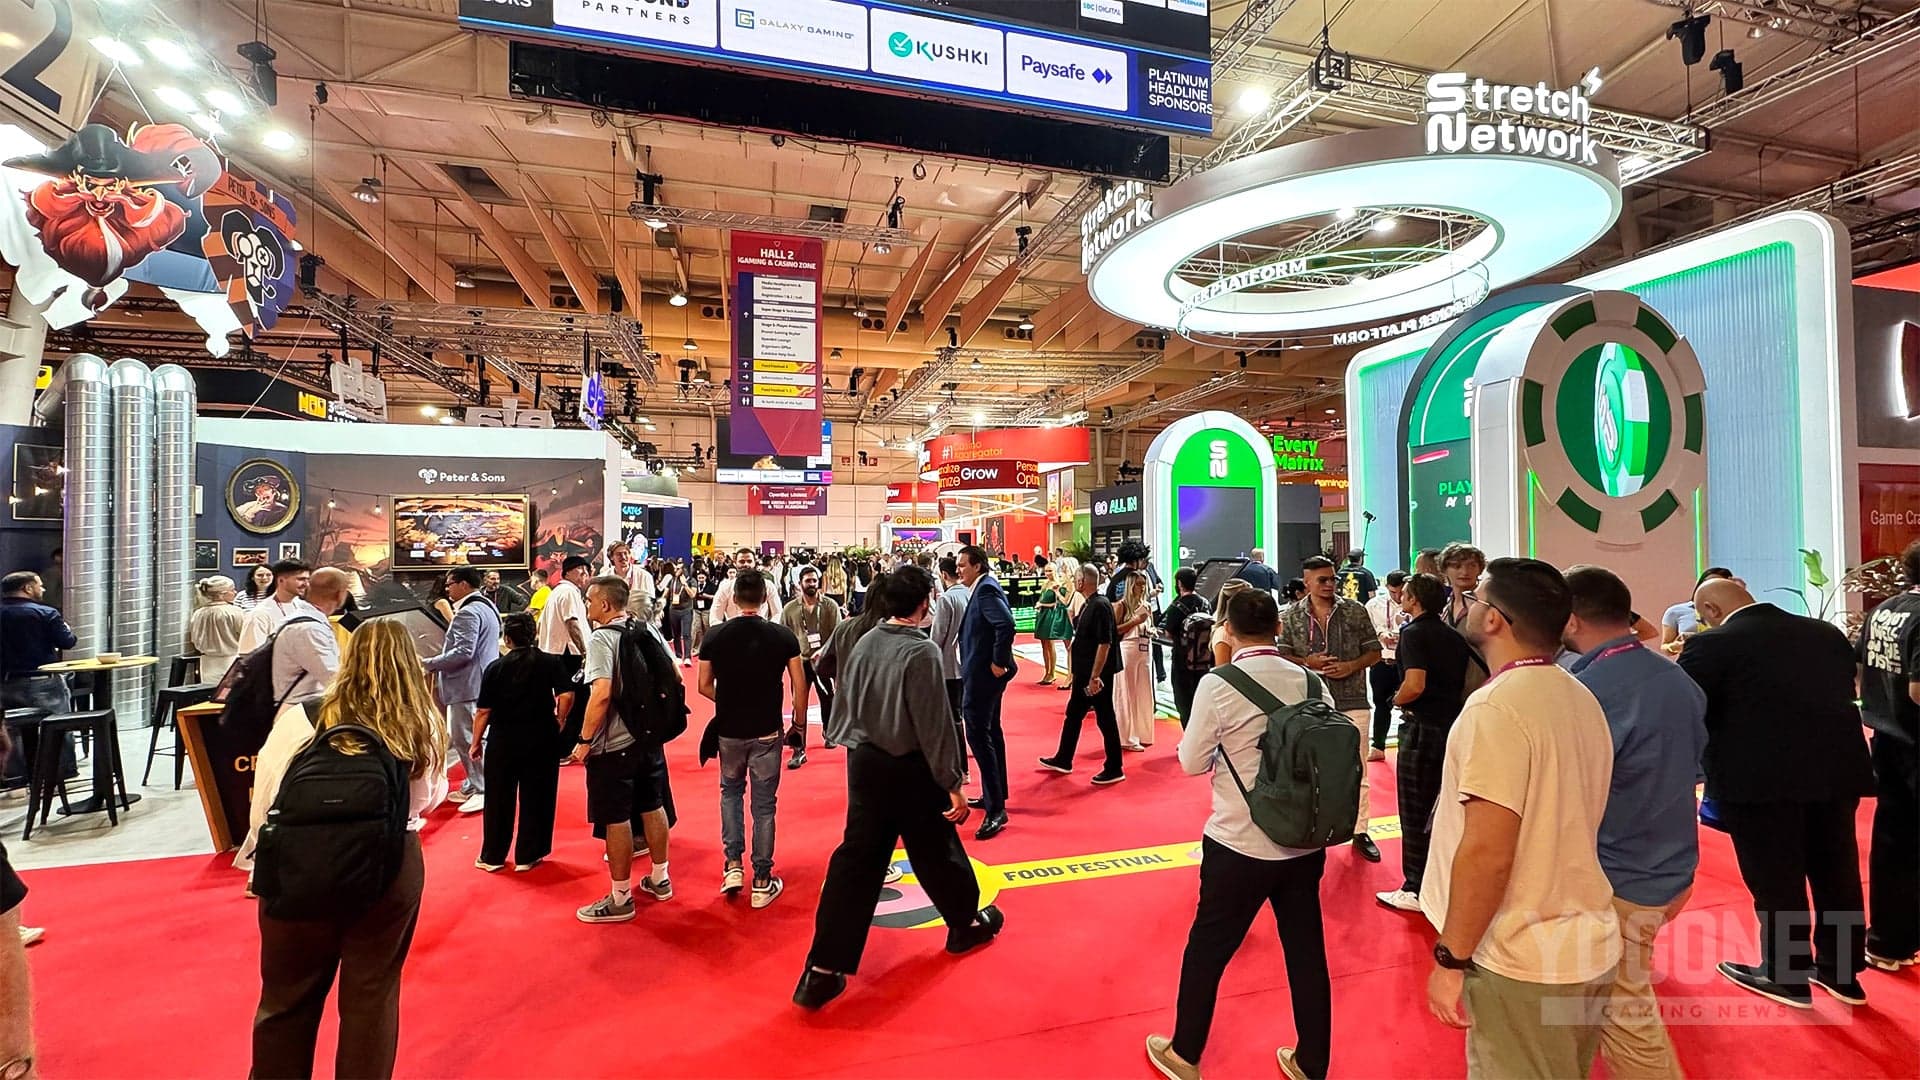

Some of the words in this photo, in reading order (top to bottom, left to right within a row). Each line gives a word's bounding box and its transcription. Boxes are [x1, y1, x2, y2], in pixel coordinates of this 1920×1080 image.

[582, 0, 691, 25] PARTNERS
[760, 18, 804, 32] GALAXY
[807, 26, 852, 39] GAMING
[916, 40, 988, 66] KUSHKI
[1022, 54, 1085, 81] Paysafe
[1148, 67, 1209, 89] PLATINUM
[1148, 80, 1208, 101] HEADLINE
[1426, 72, 1590, 124] Stretch
[1148, 94, 1213, 115] SPONSORS
[1426, 112, 1599, 164] Network
[1081, 180, 1144, 236] Stretch
[1081, 198, 1153, 274] Network
[760, 248, 787, 260] HALL
[787, 250, 795, 260] 2
[774, 260, 799, 268] CASINO
[799, 262, 817, 270] ZONE
[1212, 258, 1308, 297] PLATFORM
[1273, 435, 1319, 457] Every
[1273, 452, 1324, 471] Matrix
[440, 472, 469, 483] Peter
[470, 473, 480, 482] &
[481, 473, 506, 483] Sons
[960, 467, 998, 480] Grow
[1109, 498, 1127, 514] ALL
[1127, 496, 1137, 512] IN
[1870, 509, 1903, 525] Game
[1883, 641, 1901, 661] THE
[1002, 864, 1065, 882] FOOD
[1067, 852, 1174, 877] FESTIVAL
